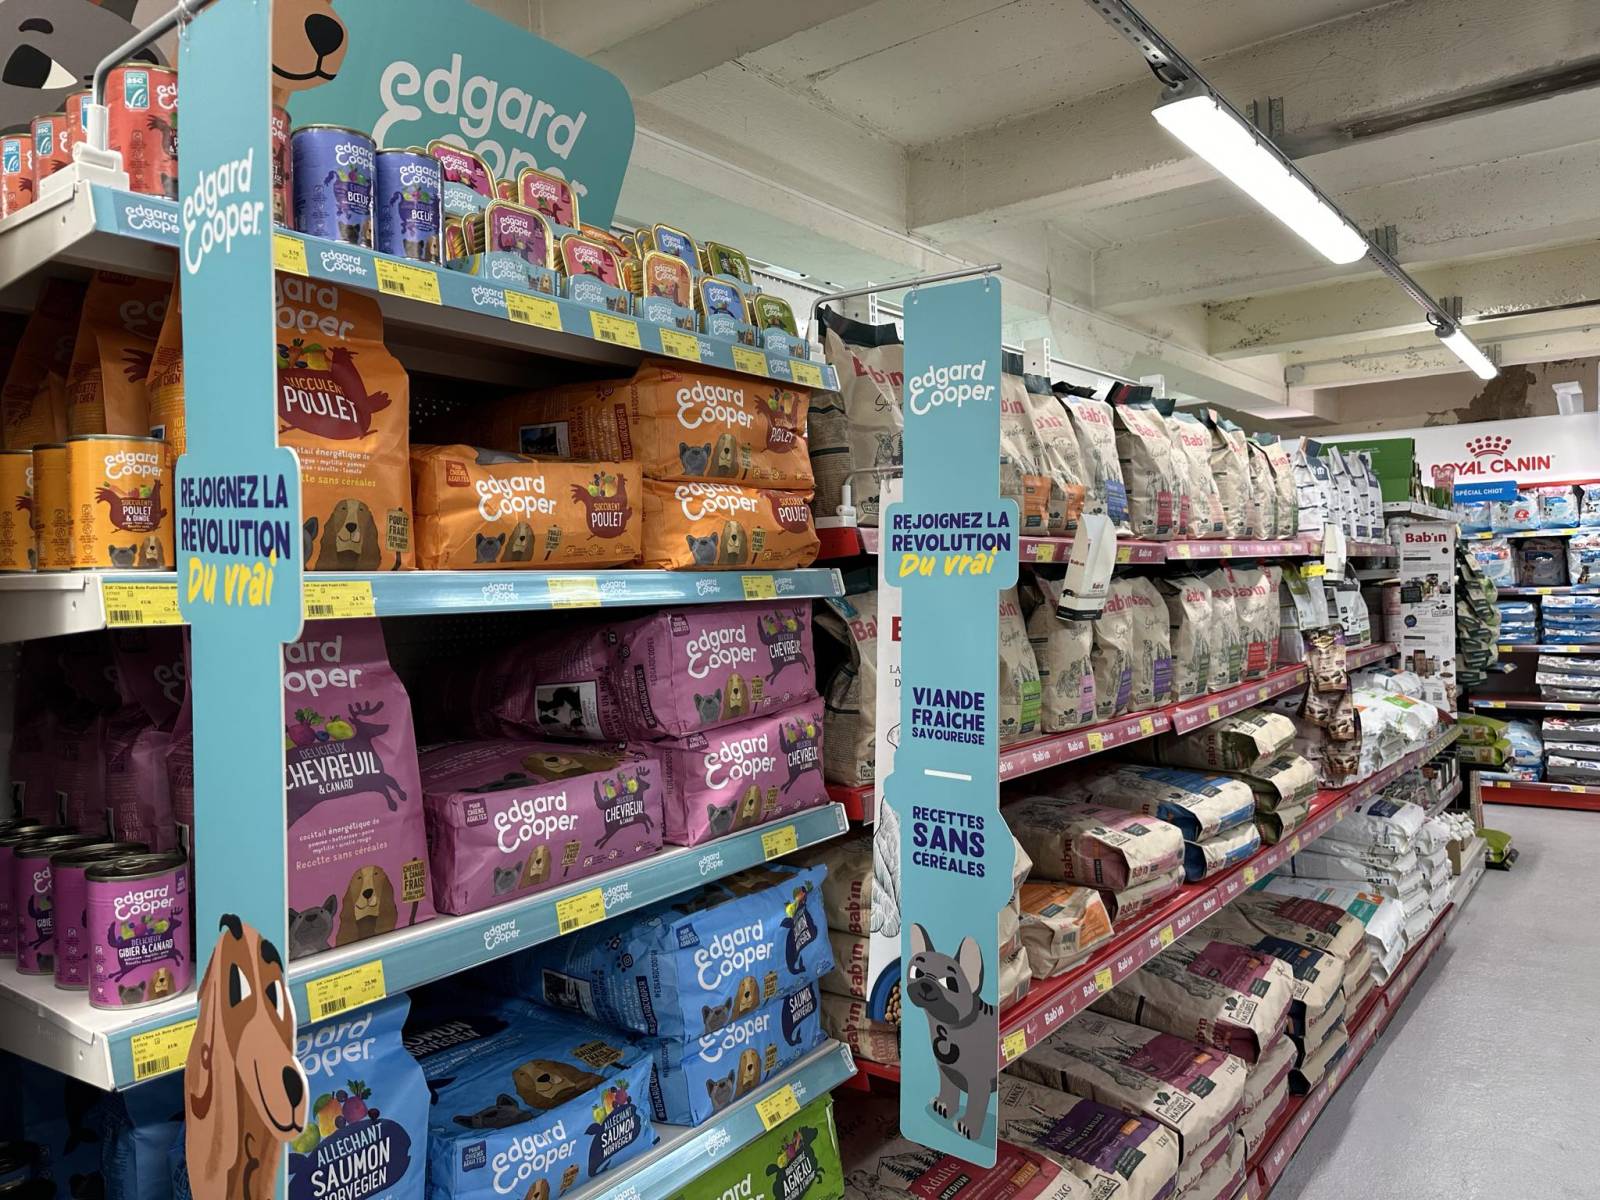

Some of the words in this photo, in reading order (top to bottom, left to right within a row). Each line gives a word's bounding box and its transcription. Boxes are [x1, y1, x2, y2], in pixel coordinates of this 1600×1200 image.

[380, 53, 587, 160] edgard
[183, 147, 254, 224] edgard
[125, 205, 178, 227] edgard
[127, 213, 179, 235] Coope
[500, 215, 528, 230] edgard
[183, 201, 265, 275] Cooper
[501, 223, 532, 237] Cooper
[320, 249, 361, 264] edgard
[322, 260, 368, 276] Cooper
[472, 285, 503, 299] edgard
[909, 360, 986, 393] edgard
[283, 385, 359, 423] POULET
[676, 380, 744, 408] edgard
[910, 384, 996, 416] Cooper
[676, 402, 754, 430] Cooper
[104, 451, 159, 466] edgard
[105, 462, 163, 479] Cooper
[1490, 455, 1551, 474] CANIN
[181, 475, 258, 508] REJOIGNEZ
[264, 473, 288, 508] LA
[475, 474, 546, 497] edgard
[1455, 487, 1482, 497] SPÉCIAL
[1483, 487, 1503, 495] CHIOT
[122, 506, 152, 516] POULET
[477, 494, 557, 522] Cooper
[591, 511, 624, 528] POULET
[681, 496, 759, 521] Cooper
[893, 512, 983, 530] REJOIGNEZ
[987, 511, 1010, 528] LA
[181, 508, 291, 560] RÉVOLUTION
[892, 529, 1011, 552] RÉVOLUTION
[1405, 531, 1448, 543] Bab'in
[899, 553, 936, 578] Du
[943, 544, 998, 577] vrai
[187, 556, 217, 605] Du
[225, 548, 277, 607] vrai
[481, 582, 514, 595] edgard
[686, 624, 747, 654] edgard
[687, 647, 757, 679] Cooper
[912, 687, 985, 711] VIANDE
[912, 727, 985, 745] SAVOUREUSE
[703, 733, 769, 770] edgard
[705, 756, 777, 790] Cooper
[318, 785, 326, 795] &
[326, 778, 354, 793] CANARD
[494, 791, 567, 829] edgard
[605, 800, 644, 823] CHEVREUIL
[912, 805, 985, 830] RECETTES
[328, 819, 371, 835] énergétique
[497, 813, 579, 854] Cooper
[912, 822, 985, 858] SANS
[296, 856, 331, 871] Recette
[333, 850, 353, 862] sans
[354, 841, 388, 857] céréales
[912, 848, 985, 878] CÉRÉALES
[113, 885, 169, 907] edgard
[404, 877, 425, 892] FRAIS
[602, 882, 629, 899] edgard
[115, 896, 174, 921] Cooper
[484, 919, 516, 939] edgard
[485, 928, 520, 950] Cooper
[694, 919, 764, 962] edgard
[119, 946, 141, 958] GIBIER
[141, 946, 148, 954] &
[148, 938, 174, 952] CANARD
[697, 941, 774, 991] Cooper
[847, 943, 864, 998] Bab'in
[301, 1037, 376, 1077] oper
[491, 1120, 566, 1169] edgard
[601, 1116, 635, 1149] SAUMON
[310, 1136, 390, 1197] SAUMON
[493, 1139, 577, 1195] Cooper
[783, 1156, 813, 1196] AGNEAU
[920, 1161, 961, 1196] Adulte
